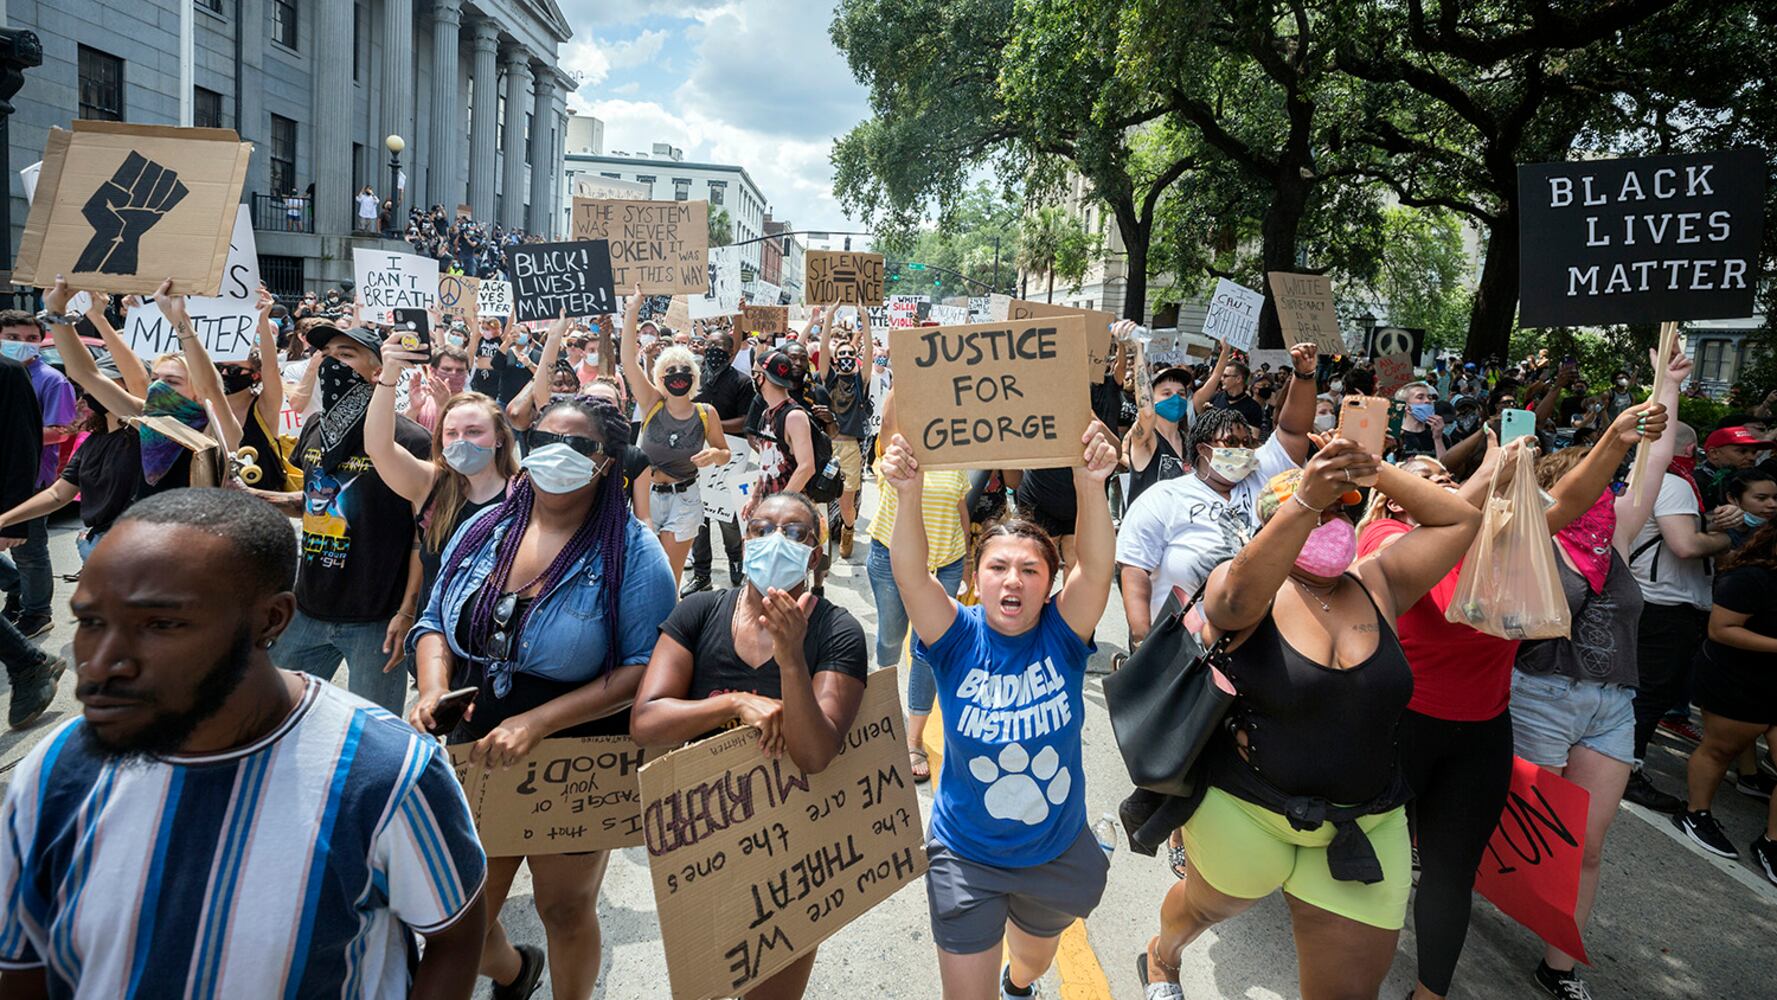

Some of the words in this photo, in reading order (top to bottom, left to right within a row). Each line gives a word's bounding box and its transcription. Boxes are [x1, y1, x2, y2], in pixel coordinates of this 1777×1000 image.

[1549, 164, 1714, 208] BLACK
[581, 204, 614, 220] THE
[623, 205, 691, 224] SYSTEM
[1586, 210, 1732, 247] LIVES
[576, 221, 609, 238] WAS
[624, 224, 678, 240] NEVER
[386, 256, 402, 270] I
[515, 249, 588, 277] BLACK!
[610, 240, 668, 262] OKEN,
[669, 240, 684, 252] IT
[678, 250, 700, 260] WAS
[519, 272, 585, 296] LIVES!
[636, 266, 674, 282] THIS
[680, 265, 704, 286] WAY
[809, 255, 882, 284] SILENCE
[1566, 258, 1748, 297] MATTER
[364, 285, 434, 308] BREATH
[479, 282, 504, 292] ACK
[480, 292, 504, 303] VES
[809, 279, 880, 304] VIOLENCE
[519, 288, 608, 320] MATTER!
[131, 315, 253, 353] MATTER
[915, 328, 1056, 368] JUSTICE
[952, 375, 1024, 406] FOR
[923, 415, 1058, 450] GEORGE
[956, 691, 1072, 742] INSTITUTE
[560, 772, 598, 796] your
[858, 764, 904, 810] WE
[530, 800, 552, 814] or
[644, 758, 810, 857] MURDERED
[806, 790, 846, 822] are
[524, 829, 534, 839] a
[548, 825, 587, 840] that
[872, 808, 910, 836] the
[739, 822, 790, 857] the
[667, 850, 726, 894] ones
[748, 834, 864, 929] THREAT
[806, 888, 844, 922] are
[724, 926, 794, 990] WE
